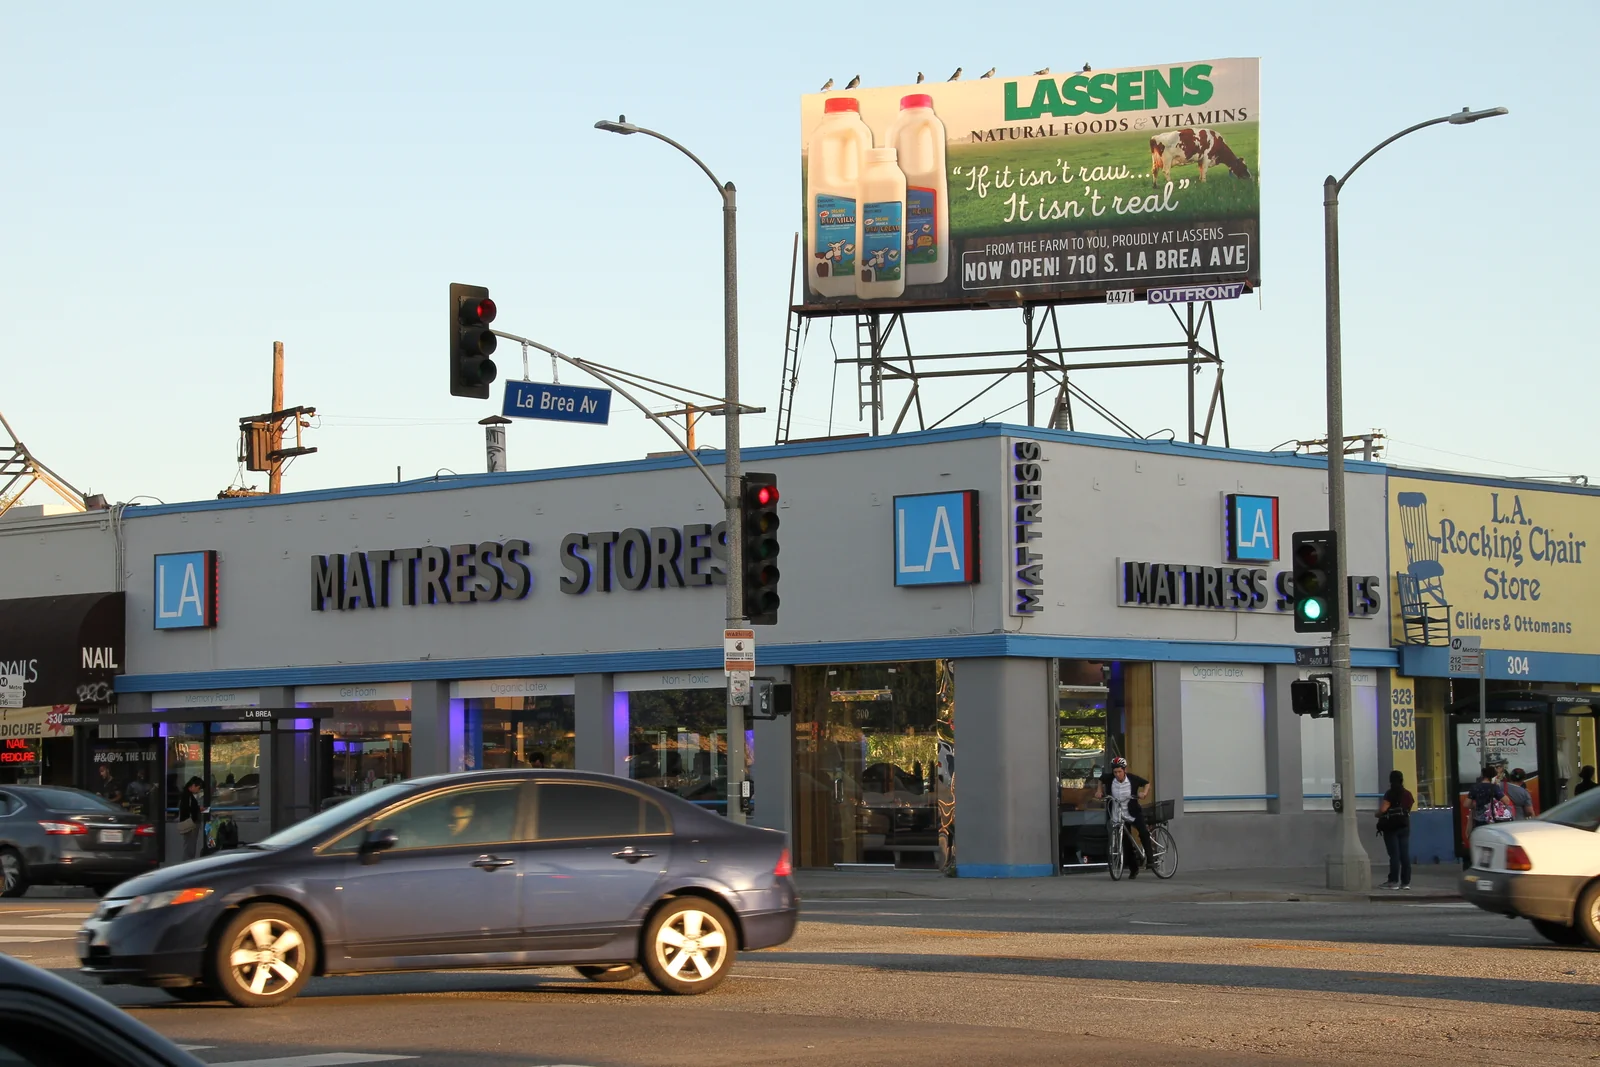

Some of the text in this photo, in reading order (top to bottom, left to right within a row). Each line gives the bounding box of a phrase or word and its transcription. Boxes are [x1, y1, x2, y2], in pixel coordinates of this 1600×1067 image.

[1004, 64, 1214, 122] LASSENS
[971, 107, 1248, 144] NATURAL FOODS & VITAMINS
[995, 169, 1014, 189] it
[986, 227, 1224, 257] FROM THE FARM TO YOU, PROUDLY AT LASSENS
[965, 245, 1246, 282] NOW OPEN! 710 S. LA BREA AVE
[1108, 291, 1133, 303] 4471
[1151, 284, 1241, 302] OUTFRONT
[516, 389, 598, 413] La Brea Av
[1490, 493, 1532, 525] L.A.
[1015, 442, 1044, 613] MATTRESS
[1237, 508, 1270, 549] LA
[898, 506, 961, 573] LA
[1439, 518, 1586, 567] Rocking Chair
[310, 539, 531, 613] MATTRESS
[1484, 568, 1541, 601] Store
[159, 562, 203, 619] LA
[1124, 561, 1381, 615] MATTRESS SES
[1455, 611, 1572, 634] Gliders & Ottomans
[82, 647, 118, 669] NAIL
[1309, 657, 1322, 665] 5600
[1507, 656, 1529, 675] 304
[1192, 666, 1244, 679] Organic Latex
[185, 692, 235, 704] Memory Foam
[339, 687, 377, 697] Gel Foam
[490, 682, 548, 695] Organic Latex
[48, 713, 62, 724] $30
[6, 739, 28, 749] NAIL
[1392, 730, 1415, 750] 7858
[1, 752, 35, 762] PEDICURE
[125, 752, 139, 761] THE
[141, 751, 157, 761] TUX
